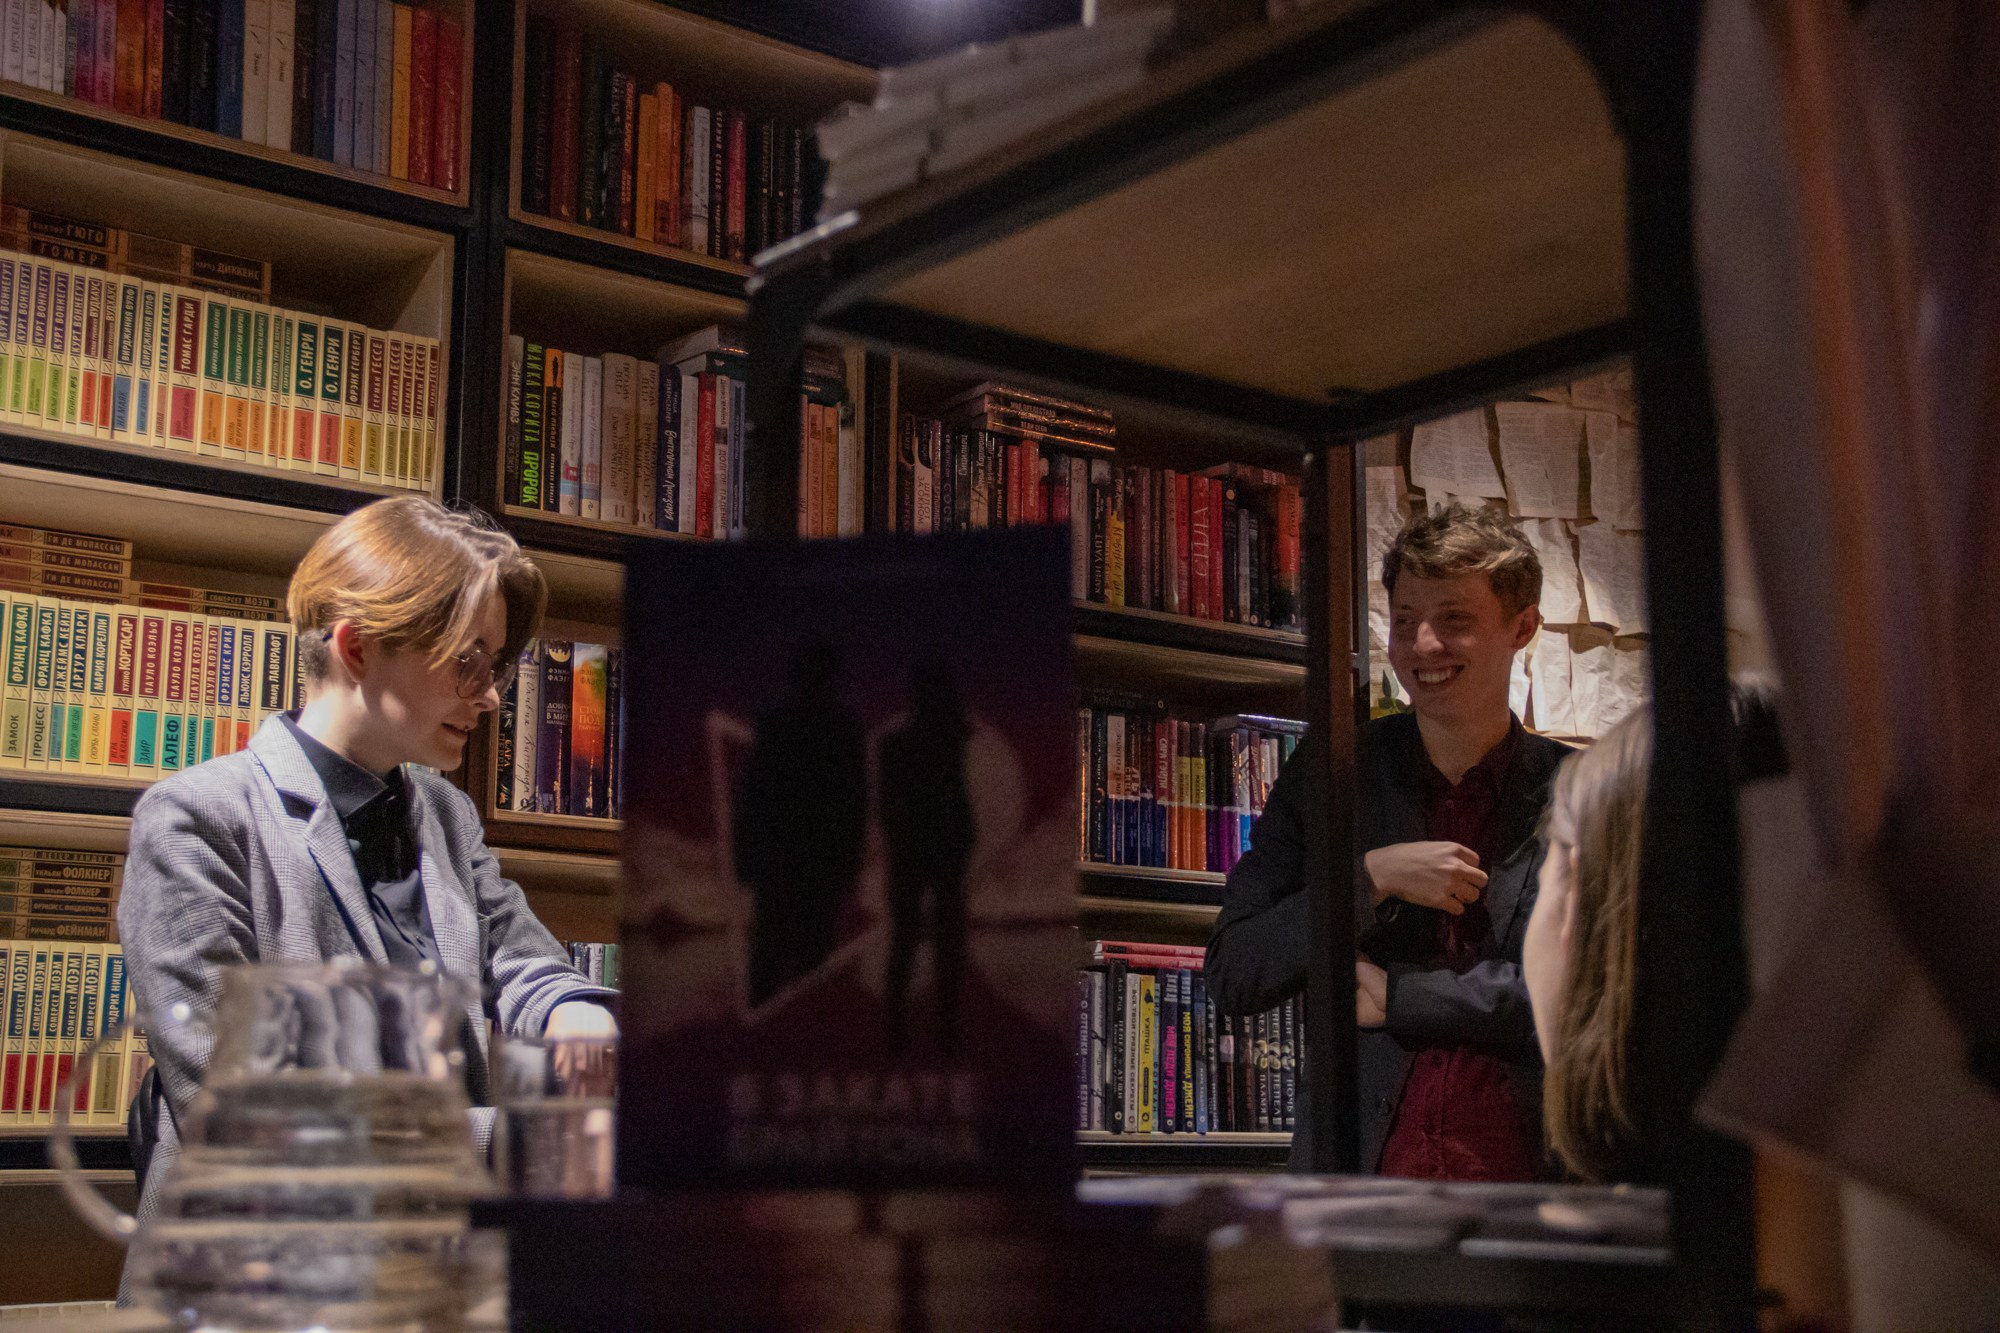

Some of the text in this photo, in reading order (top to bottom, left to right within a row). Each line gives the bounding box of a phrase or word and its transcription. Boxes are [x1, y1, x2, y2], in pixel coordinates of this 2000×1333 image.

[39, 243, 98, 265] ГОМЕР
[66, 225, 104, 244] ГЮГО
[1, 263, 12, 314] ВОННЕГУТ
[19, 264, 32, 315] ВОННЕГУТ
[216, 262, 260, 280] ДИККЕНС
[34, 267, 51, 344] КУРТ ВОННЕГУТ
[53, 275, 69, 350] КУРТ ВОННЕГУТ
[71, 279, 85, 354] КУРТ ВОННЕГУТ
[89, 280, 101, 318] ВУДХАУС
[106, 284, 117, 322] ВУДХАУС
[17, 318, 28, 341] КУРТ
[121, 288, 136, 362] ВИРДЖИНИЯ ВУЛФ
[142, 293, 155, 367] ВИРДЖИНИЯ ВУЛФ
[159, 294, 172, 372] КНУТ ГАМСУН
[181, 302, 196, 370] ТОМАС ГАРДИ
[235, 356, 243, 383] ГАБРИЭЛЬ
[299, 332, 315, 389] О. ГЕНРИ
[325, 336, 340, 394] О. ГЕНРИ
[349, 333, 362, 402] ФРЭНК ГЕРБЕРТ
[373, 341, 383, 408] ГЕРМАН ГЕССЕ
[390, 343, 401, 379] ГЕССЕ
[403, 346, 414, 415] ГЕРМАН ГЕССЕ
[416, 346, 426, 415] ГЕРМАН ГЕССЕ
[68, 390, 77, 416] БОЙНЯ
[117, 391, 128, 428] НА МАЯК
[510, 361, 522, 424] ЭНН КЛИВЗ
[522, 342, 543, 504] МАЙКА КОРИТА ПРОРОК
[976, 432, 985, 467] Корлеоне
[919, 475, 924, 487] ЗА
[45, 553, 119, 571] ГИ ДЕ МОПАССАН
[48, 534, 121, 553] ГИ ДЕ МОПАССАН
[45, 573, 119, 591] ГИ ДЕ МОПАССАН
[209, 594, 270, 608] СОМЕРСЕТ МОЭМ
[59, 611, 71, 638] КЕЙН
[208, 608, 268, 621] СОМЕРСЕТ МОЭМ
[12, 607, 28, 682] ФРАНЦ КАФКА
[37, 611, 53, 687] ФРАНЦ КАФКА
[55, 642, 70, 689] ДЖЕЙМС
[72, 613, 88, 689] АРТУР КЛАРК
[94, 618, 108, 690] МАРИЯ КОРЕЛЛИ
[118, 619, 134, 670] КОРТАСАР
[146, 621, 158, 694] ПАУЛО КОЭЛЬО
[170, 625, 184, 698] ПАУЛО КОЭЛЬО
[191, 626, 202, 700] ПАУЛО КОЭЛЬО
[206, 630, 218, 701] ПАУЛО КОЭЛЬО
[220, 630, 234, 702] ФРЭНСИС КРИК
[239, 634, 254, 704] ЛЬЮИС КЭРРОЛЛ
[268, 634, 282, 708] ГОВАРД ЛАВКРАФТ
[9, 715, 19, 752] ЗАМОК
[33, 706, 45, 756] ПРОЦЕСС
[546, 712, 569, 720] В МИР
[579, 714, 600, 724] ПОД
[140, 740, 151, 764] ЗАИР
[164, 719, 179, 766] АЛЕФ
[186, 721, 197, 765] АЛХИМИК
[63, 866, 110, 881] ФОЛКНЕР
[64, 886, 101, 896] ФОЛКНЕР
[57, 924, 106, 937] ФЕЙНМАН
[13, 955, 29, 1035] СОМЕРСЕТ МОЭМ
[32, 962, 46, 1031] СОМЕРСЕТ МОЭМ
[49, 961, 63, 1032] СОМЕРСЕТ МОЭМ
[66, 958, 81, 1036] СОМЕРСЕТ МОЭМ
[85, 958, 100, 1037] СОМЕРСЕТ МОЭМ
[111, 959, 123, 991] НИЦШЕ
[1080, 1013, 1088, 1055] ОТТЕНКИ
[1182, 1011, 1191, 1032] МОЯ
[1165, 1049, 1175, 1076] ЛЕДИ
[1080, 1084, 1088, 1128] БЕЗУМИЯ
[1165, 1078, 1175, 1118] ДЖЕЙН
[1182, 1080, 1193, 1118] ДЖЕЙН
[1259, 1074, 1267, 1114] ПЛАМЯ
[1273, 1074, 1281, 1116] ПЕПЕЛ
[1286, 1079, 1294, 1113] НОЧЬ
